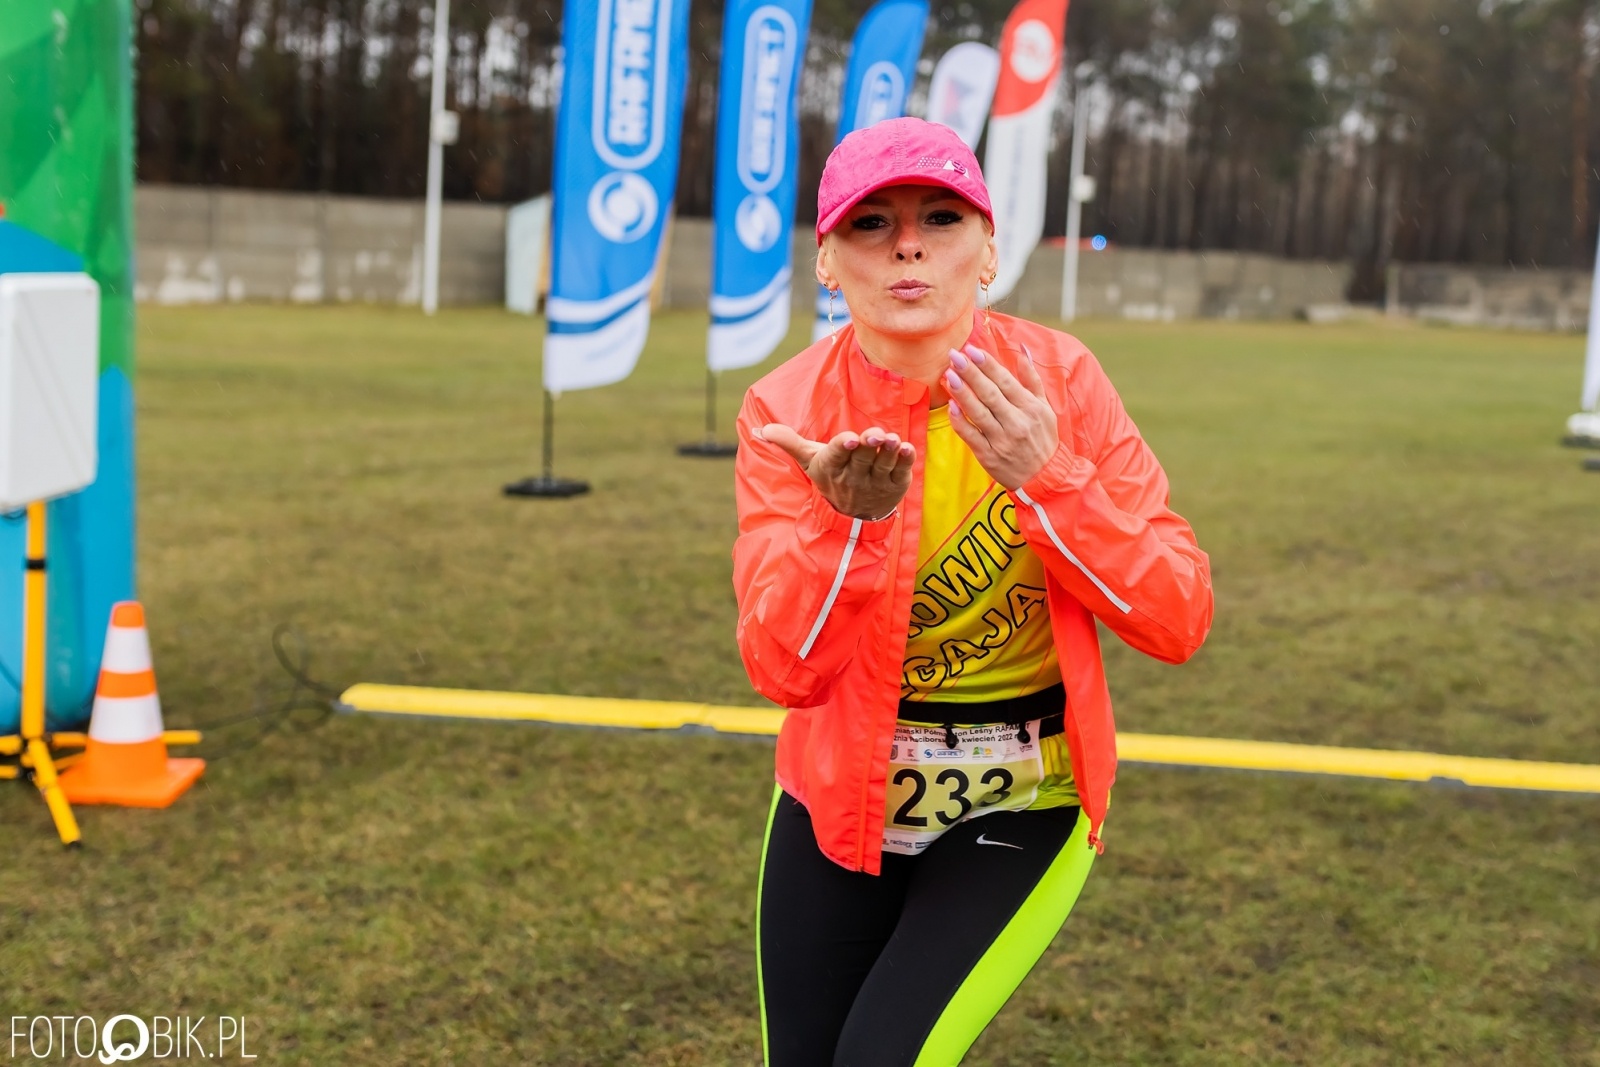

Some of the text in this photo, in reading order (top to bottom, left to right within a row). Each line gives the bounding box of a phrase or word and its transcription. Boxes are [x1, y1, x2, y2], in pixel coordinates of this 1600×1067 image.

[609, 0, 656, 144] RAFAME
[908, 490, 1027, 638] OWIC
[900, 583, 1047, 700] GAJA
[962, 735, 995, 743] kwiecień
[998, 733, 1013, 742] 2022
[970, 727, 993, 735] Leśny
[995, 722, 1030, 732] RAFAMT
[893, 768, 1014, 827] 233
